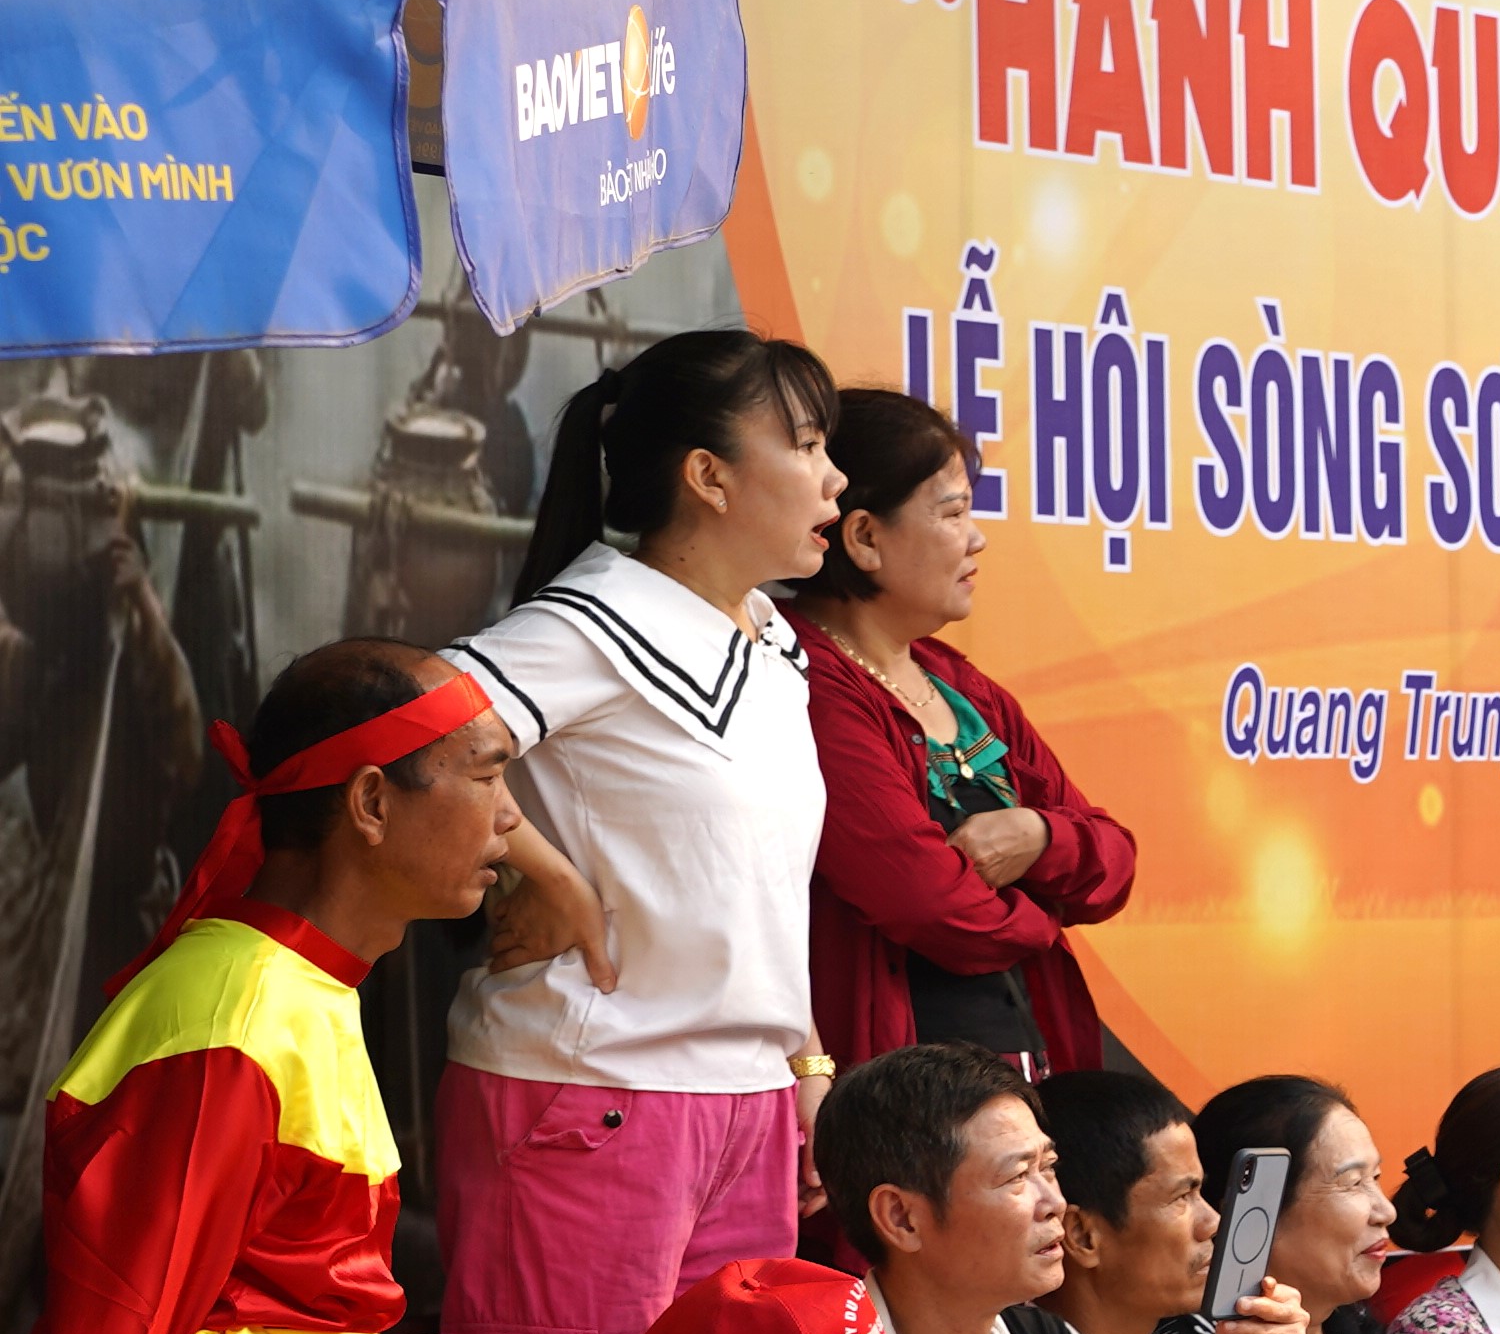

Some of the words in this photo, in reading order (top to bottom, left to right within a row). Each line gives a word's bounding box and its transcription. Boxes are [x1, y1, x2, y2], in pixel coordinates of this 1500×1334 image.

[0, 91, 57, 142] ẾN
[61, 93, 149, 141] VÀO
[515, 40, 624, 142] BAOVIET
[6, 158, 134, 201] VƯƠN
[138, 153, 234, 202] MÌNH
[0, 216, 50, 274] ỘC
[1034, 292, 1168, 566] HỘI
[1198, 303, 1403, 541] SÒNG
[1225, 666, 1386, 781] Quang
